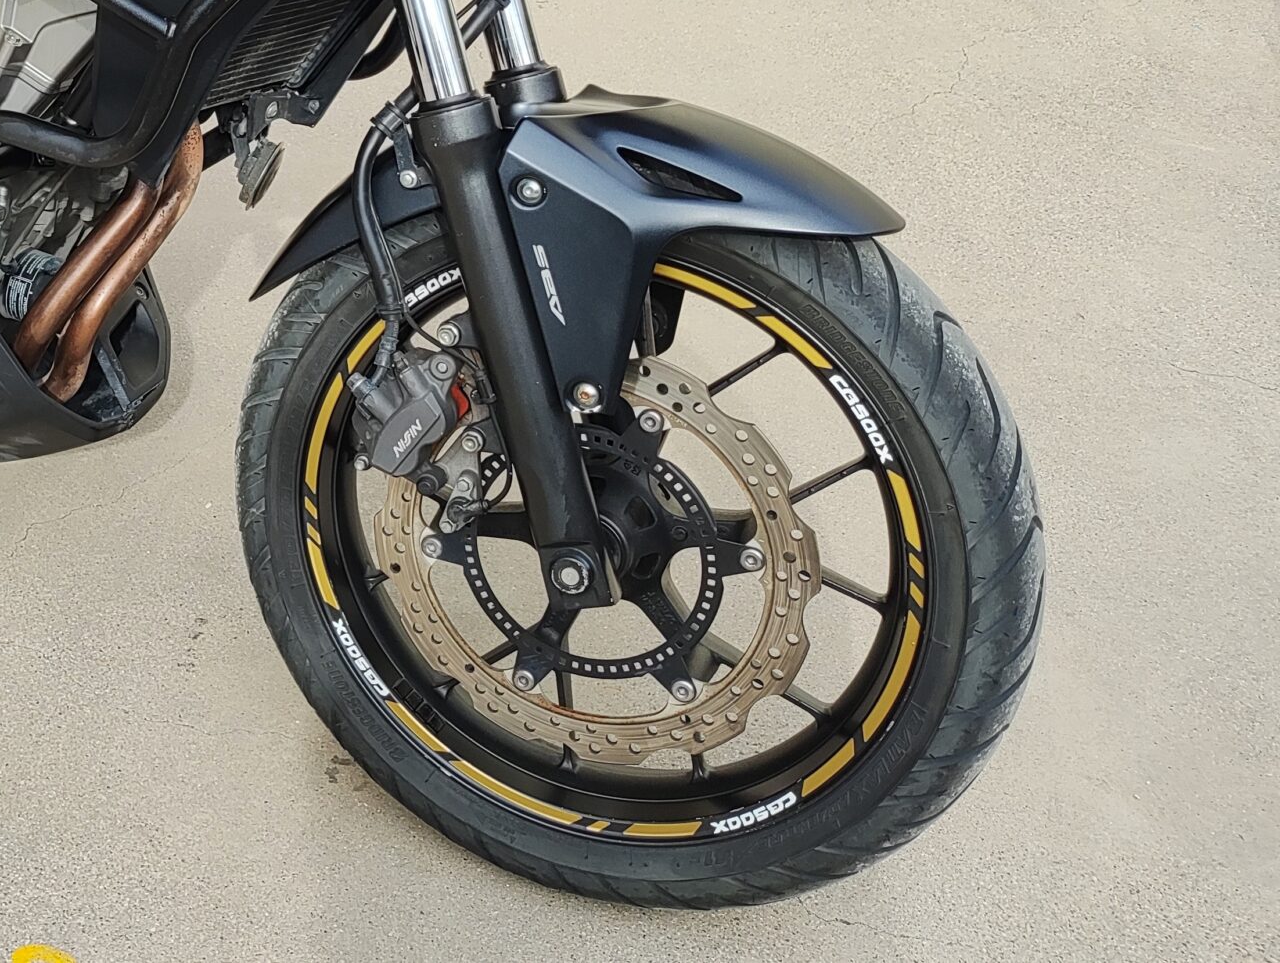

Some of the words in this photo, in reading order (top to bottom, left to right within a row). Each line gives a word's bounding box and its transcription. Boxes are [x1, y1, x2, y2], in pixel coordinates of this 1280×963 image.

[404, 267, 461, 307] B500X
[532, 244, 566, 326] ABS
[828, 374, 894, 465] CB500X
[332, 618, 390, 698] CB500X
[710, 791, 798, 835] CB500X
